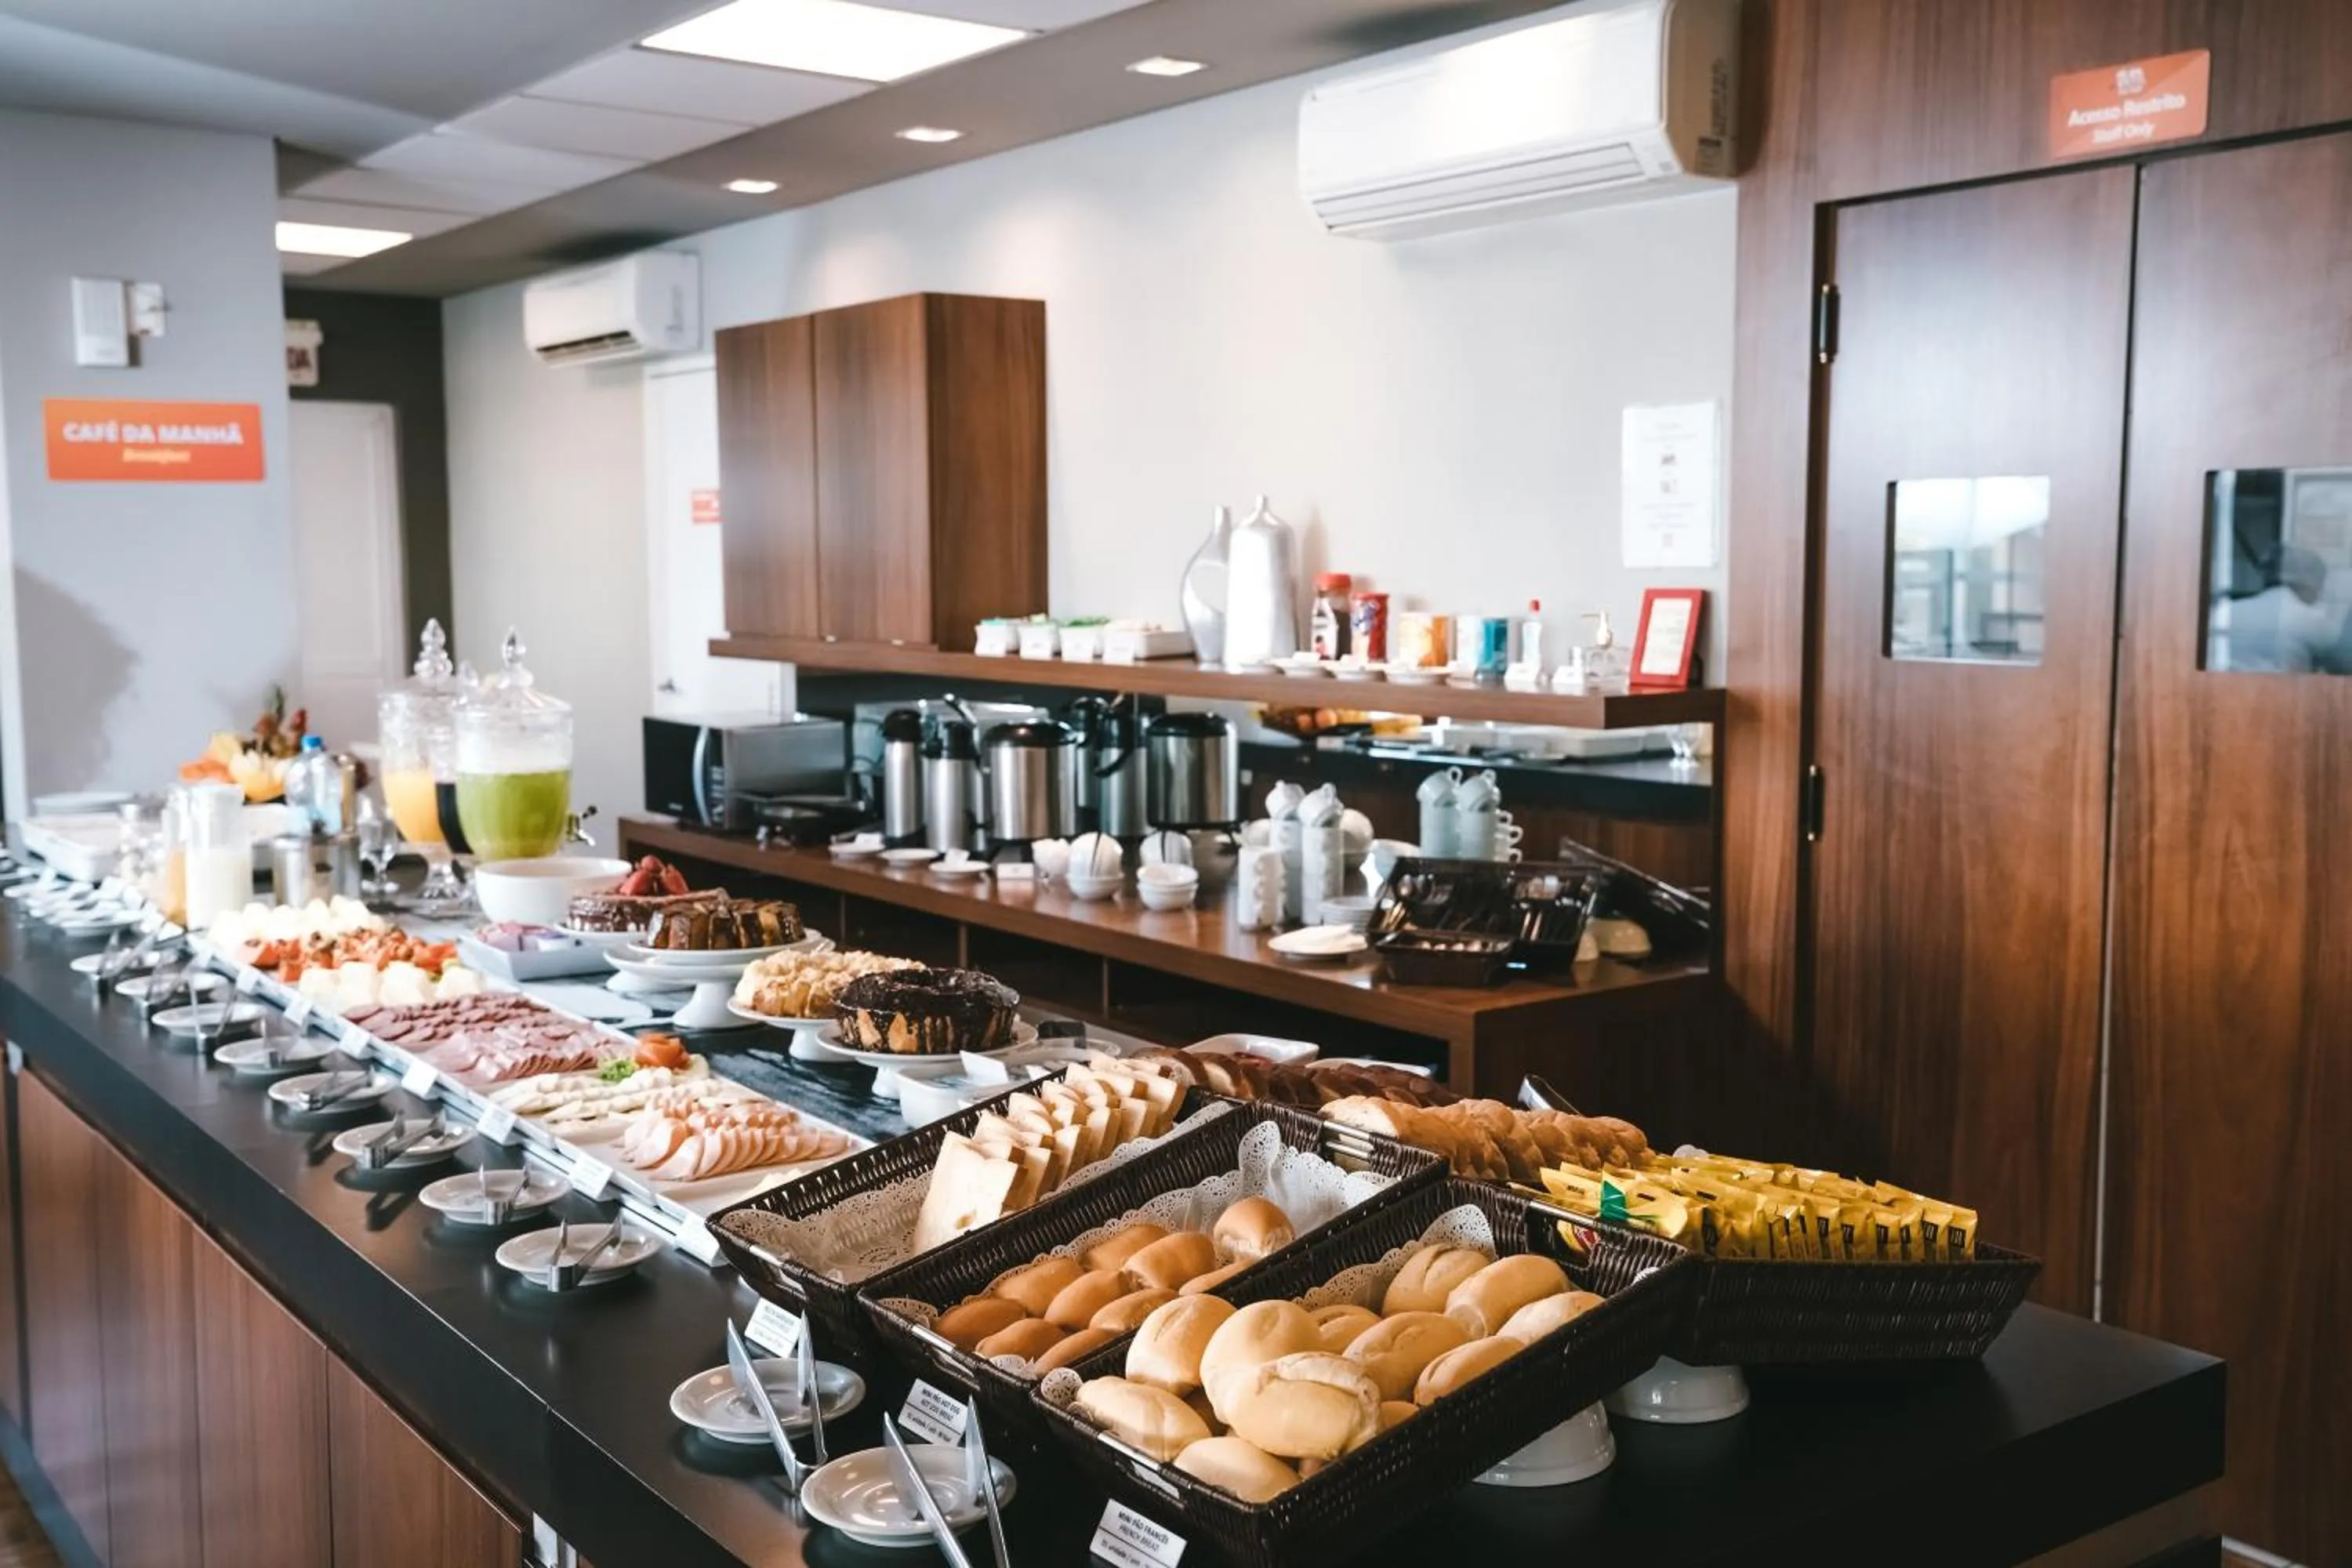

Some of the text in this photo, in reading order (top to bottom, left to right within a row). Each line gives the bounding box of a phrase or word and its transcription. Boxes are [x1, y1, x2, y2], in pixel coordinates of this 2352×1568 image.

[63, 419, 244, 445] CAFÉ DA MANHÃ
